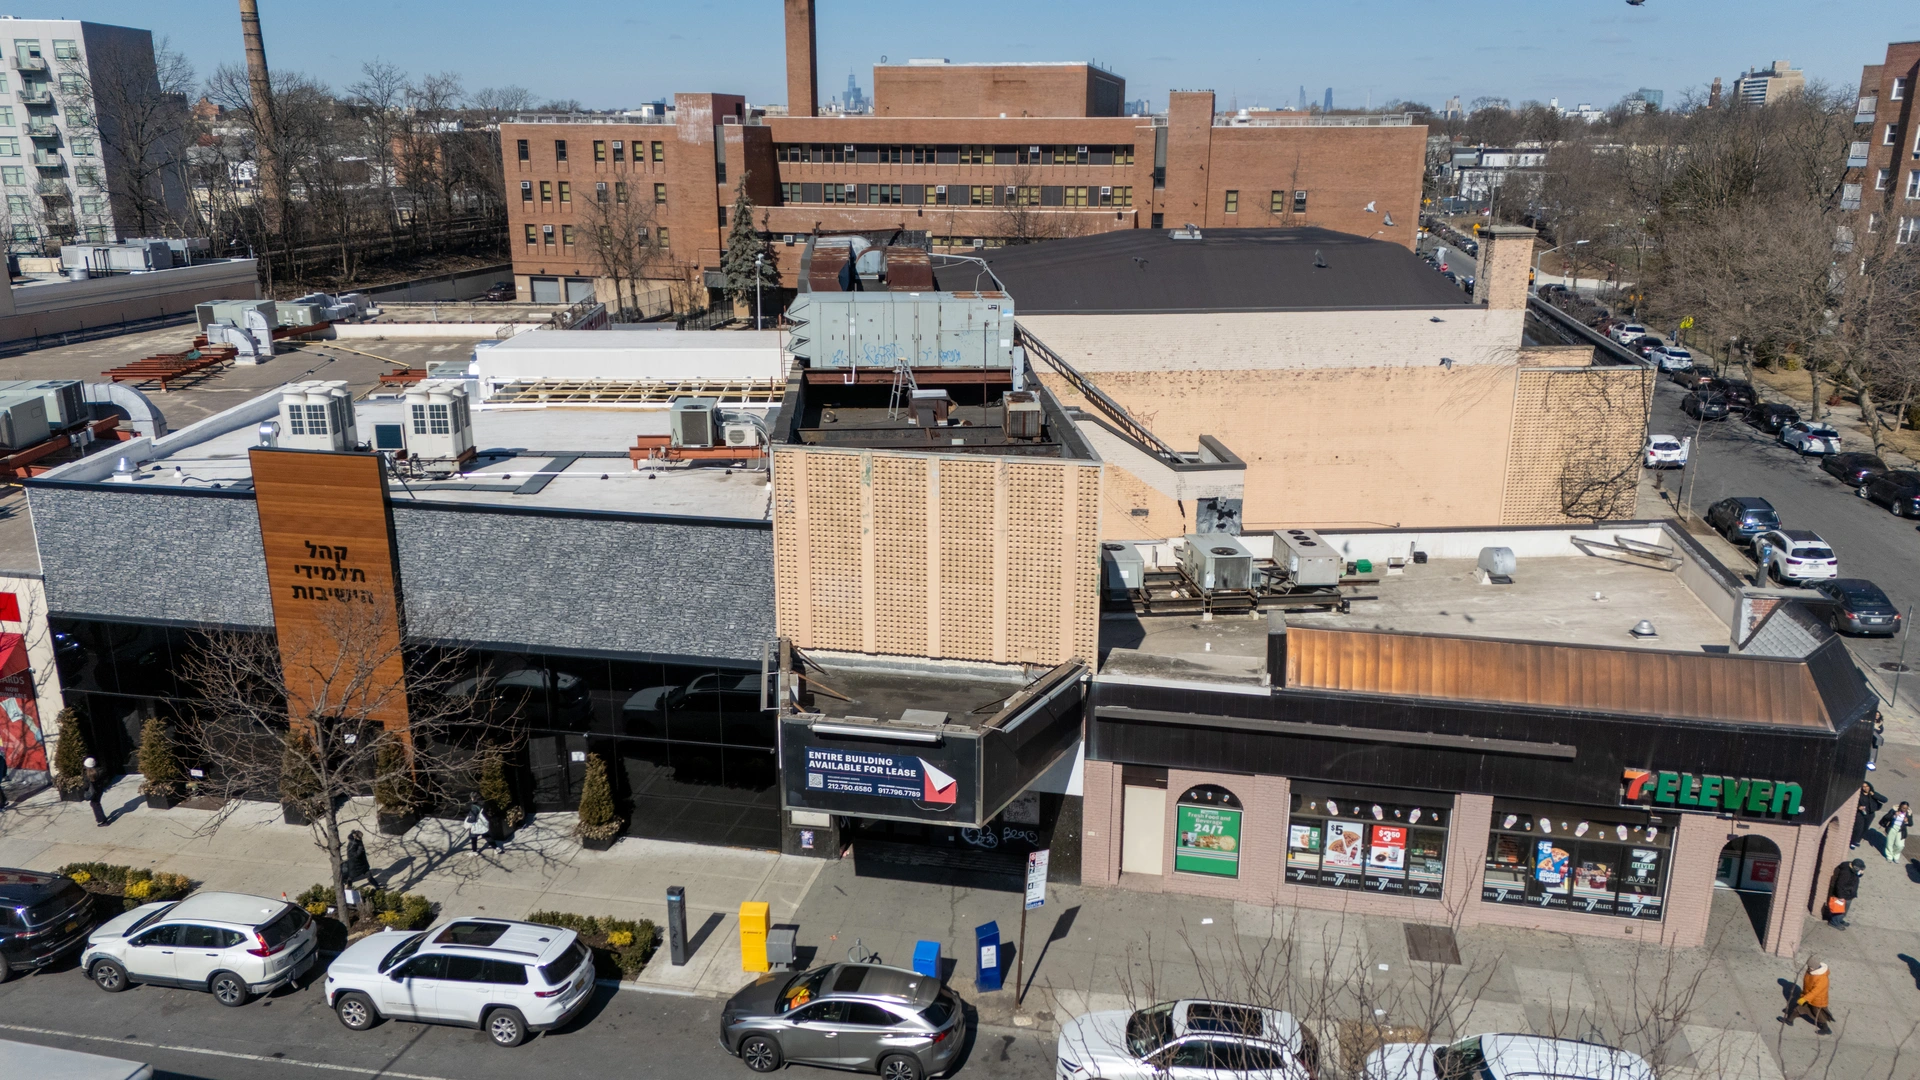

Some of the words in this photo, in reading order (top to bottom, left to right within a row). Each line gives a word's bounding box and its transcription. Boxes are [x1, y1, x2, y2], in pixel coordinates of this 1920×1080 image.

[304, 540, 348, 564] קהל
[294, 564, 366, 583] תלמידי
[291, 585, 374, 604] הישיבות
[0, 676, 25, 684] ARDS
[809, 751, 843, 761] ENTIRE
[845, 755, 893, 766] BUILDING
[809, 760, 861, 772] AVAILABLE
[864, 765, 883, 774] FOR
[886, 768, 916, 777] LEASE
[827, 783, 872, 793] 212.750.6580
[1194, 824, 1223, 834] 24/7
[1331, 825, 1343, 835] $5
[1538, 842, 1552, 854] $5
[1335, 873, 1346, 885] 7
[1378, 878, 1389, 890] 7
[1497, 889, 1508, 901] 7
[1541, 893, 1553, 905] 7
[1586, 898, 1598, 911] 7
[1632, 903, 1644, 916] 7
